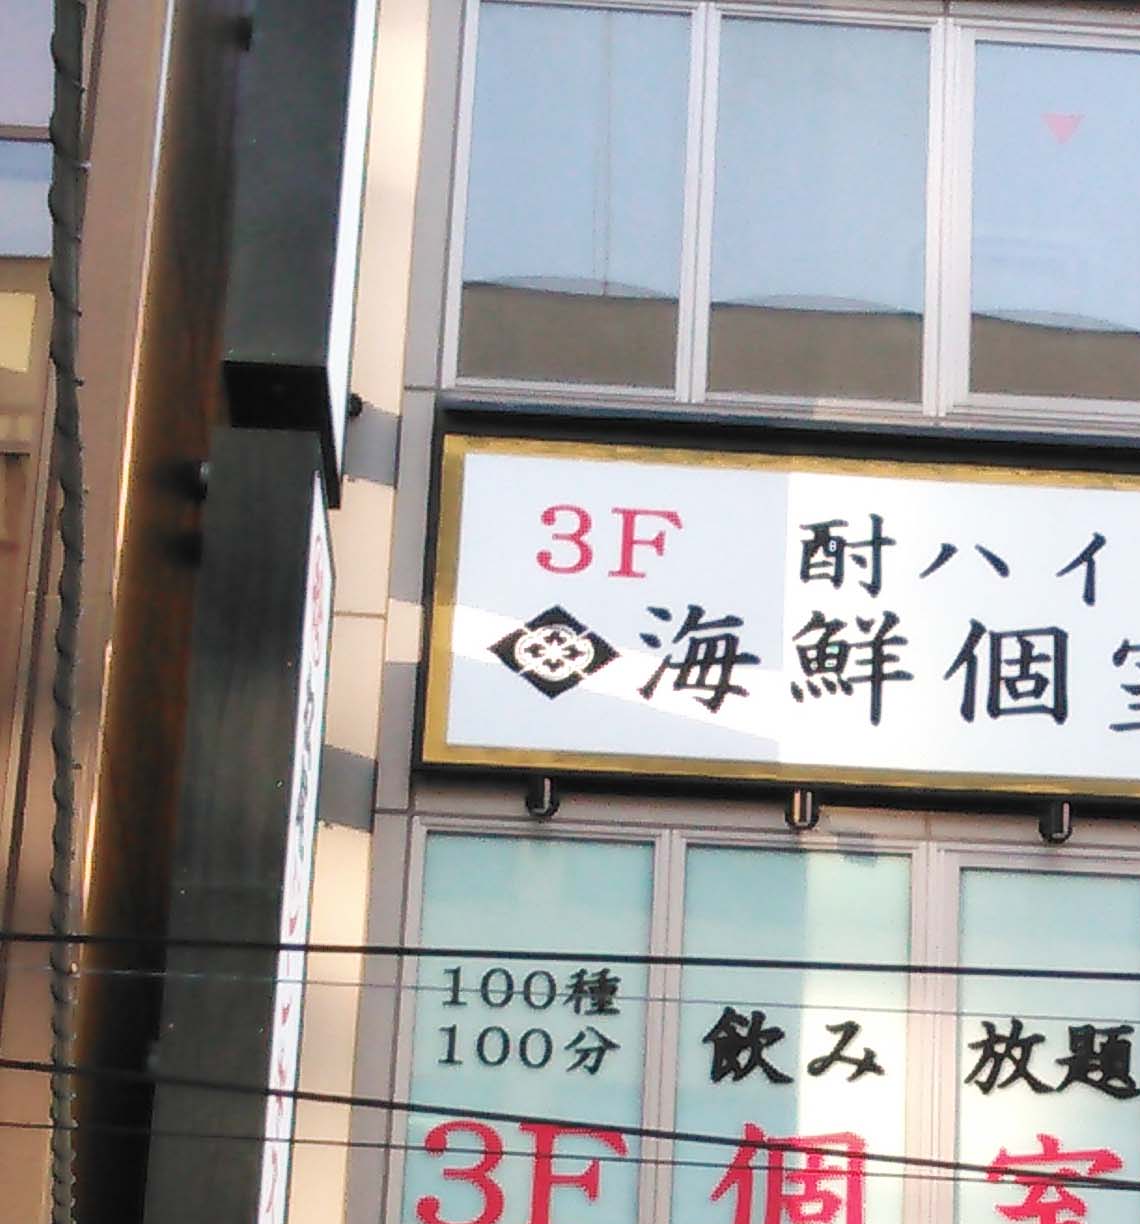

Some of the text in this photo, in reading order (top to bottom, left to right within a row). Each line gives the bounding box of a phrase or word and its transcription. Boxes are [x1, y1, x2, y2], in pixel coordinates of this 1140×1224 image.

[536, 504, 683, 578] 3F
[441, 967, 622, 1017] 100種
[436, 1025, 621, 1075] 100分
